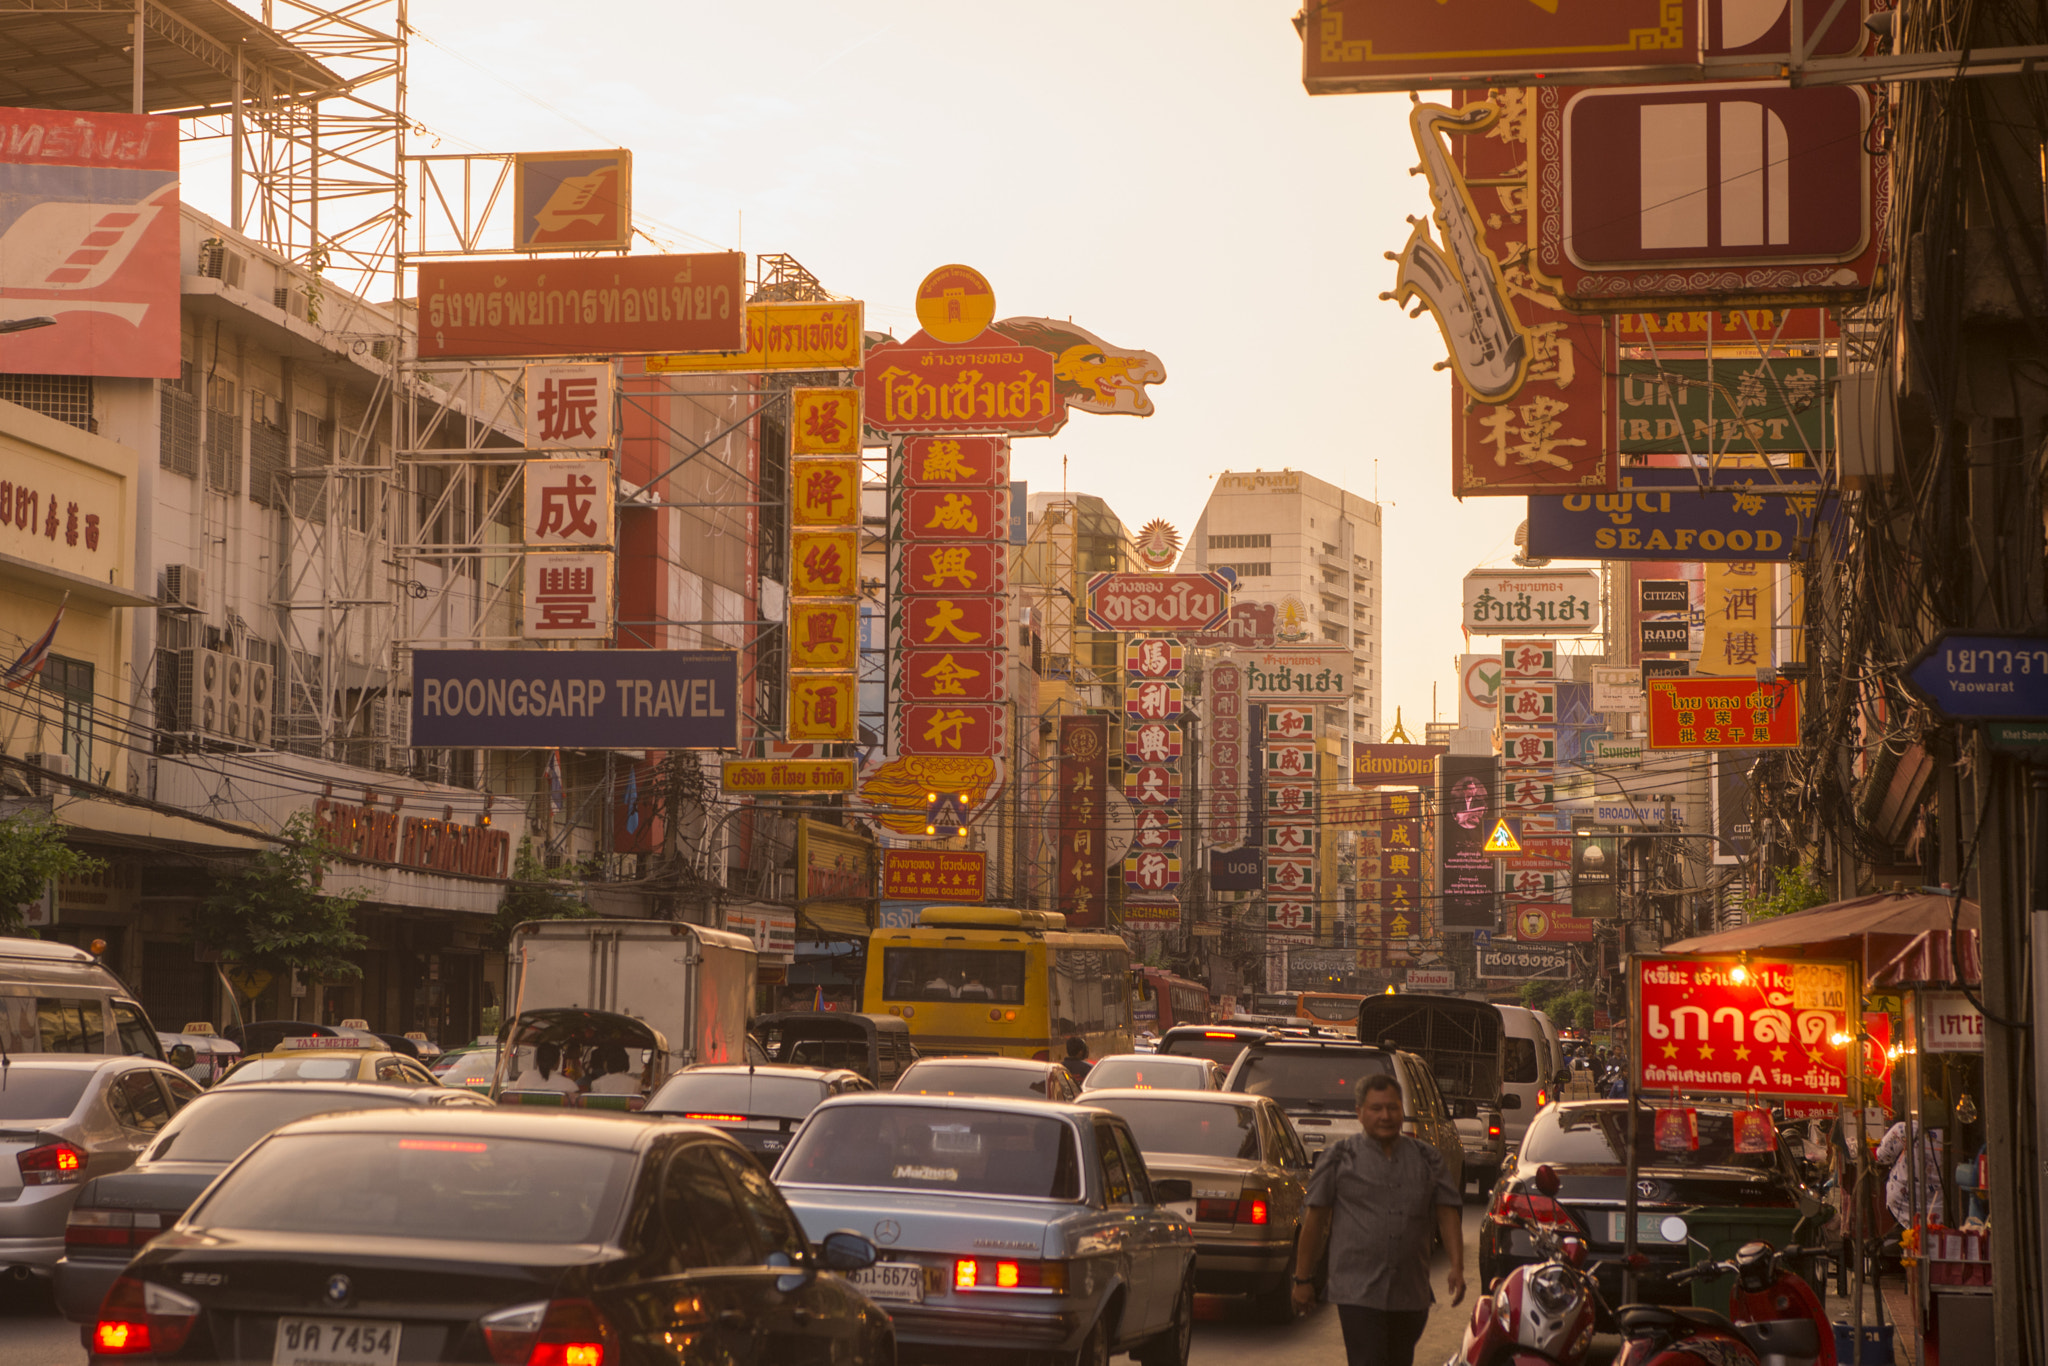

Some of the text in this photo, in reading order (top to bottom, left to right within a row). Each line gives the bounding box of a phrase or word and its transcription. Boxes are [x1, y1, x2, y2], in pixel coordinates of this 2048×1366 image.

[1619, 312, 1707, 333] HARK
[1692, 418, 1789, 441] NEST
[1594, 528, 1783, 551] SEAFOOD
[1643, 591, 1686, 601] CITIZEN
[1644, 629, 1687, 640] RADO
[1949, 681, 2015, 692] Yaowarat
[422, 678, 726, 718] ROONGSARP TRAVEL
[1667, 692, 1702, 709] ไทย
[1355, 750, 1434, 774] เลี่ยงเซ่งเฮ
[1514, 647, 1543, 897] 和成興大行
[1598, 807, 1684, 820] BROADWAY HOEL
[1228, 862, 1258, 875] UOB
[941, 887, 980, 896] GOLDSMITH
[1124, 907, 1179, 919] EXCHANGE
[344, 1021, 363, 1029] TAXI
[1648, 992, 1838, 1044] เกาลัด
[188, 1024, 207, 1033] TAXI
[295, 1037, 360, 1049] TAXI-METER
[1747, 1065, 1767, 1085] A
[331, 1326, 392, 1354] 7454
